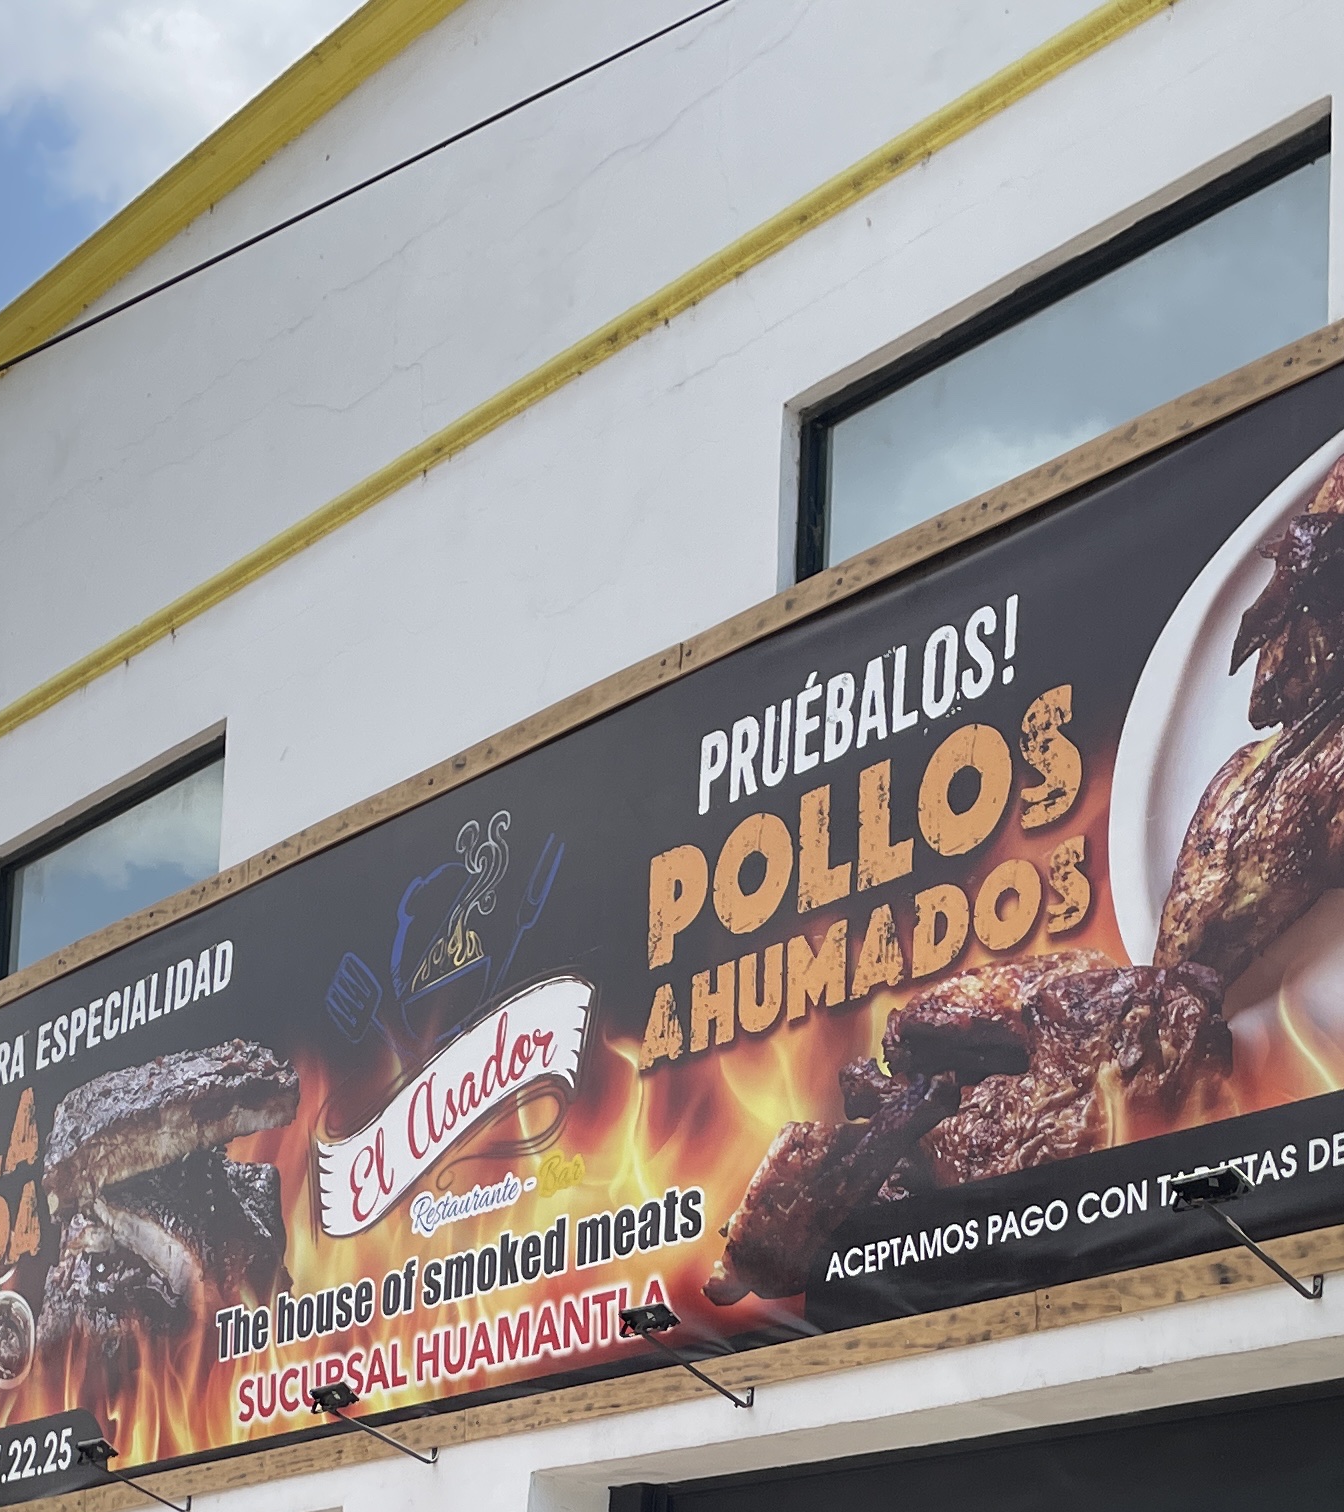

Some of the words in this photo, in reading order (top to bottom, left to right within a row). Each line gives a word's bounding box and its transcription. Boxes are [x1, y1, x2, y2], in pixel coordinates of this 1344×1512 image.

[698, 594, 1019, 815] PRUÉBALOS!
[649, 684, 1082, 969] POLLOS
[36, 940, 234, 1070] ESPECIALIDAD
[639, 835, 1091, 1069] AHUMADOS
[350, 1127, 394, 1222] El
[407, 1012, 555, 1160] Asador
[413, 1177, 518, 1231] Restaurante
[540, 1155, 582, 1194] Bar
[218, 1306, 269, 1358] The
[277, 1280, 373, 1344] house
[382, 1259, 416, 1316] of
[423, 1231, 565, 1305] smoked
[576, 1189, 703, 1267] meats
[825, 1217, 978, 1281] ACEPTAMOS
[986, 1199, 1068, 1245] PAGO
[1077, 1179, 1148, 1224] CON
